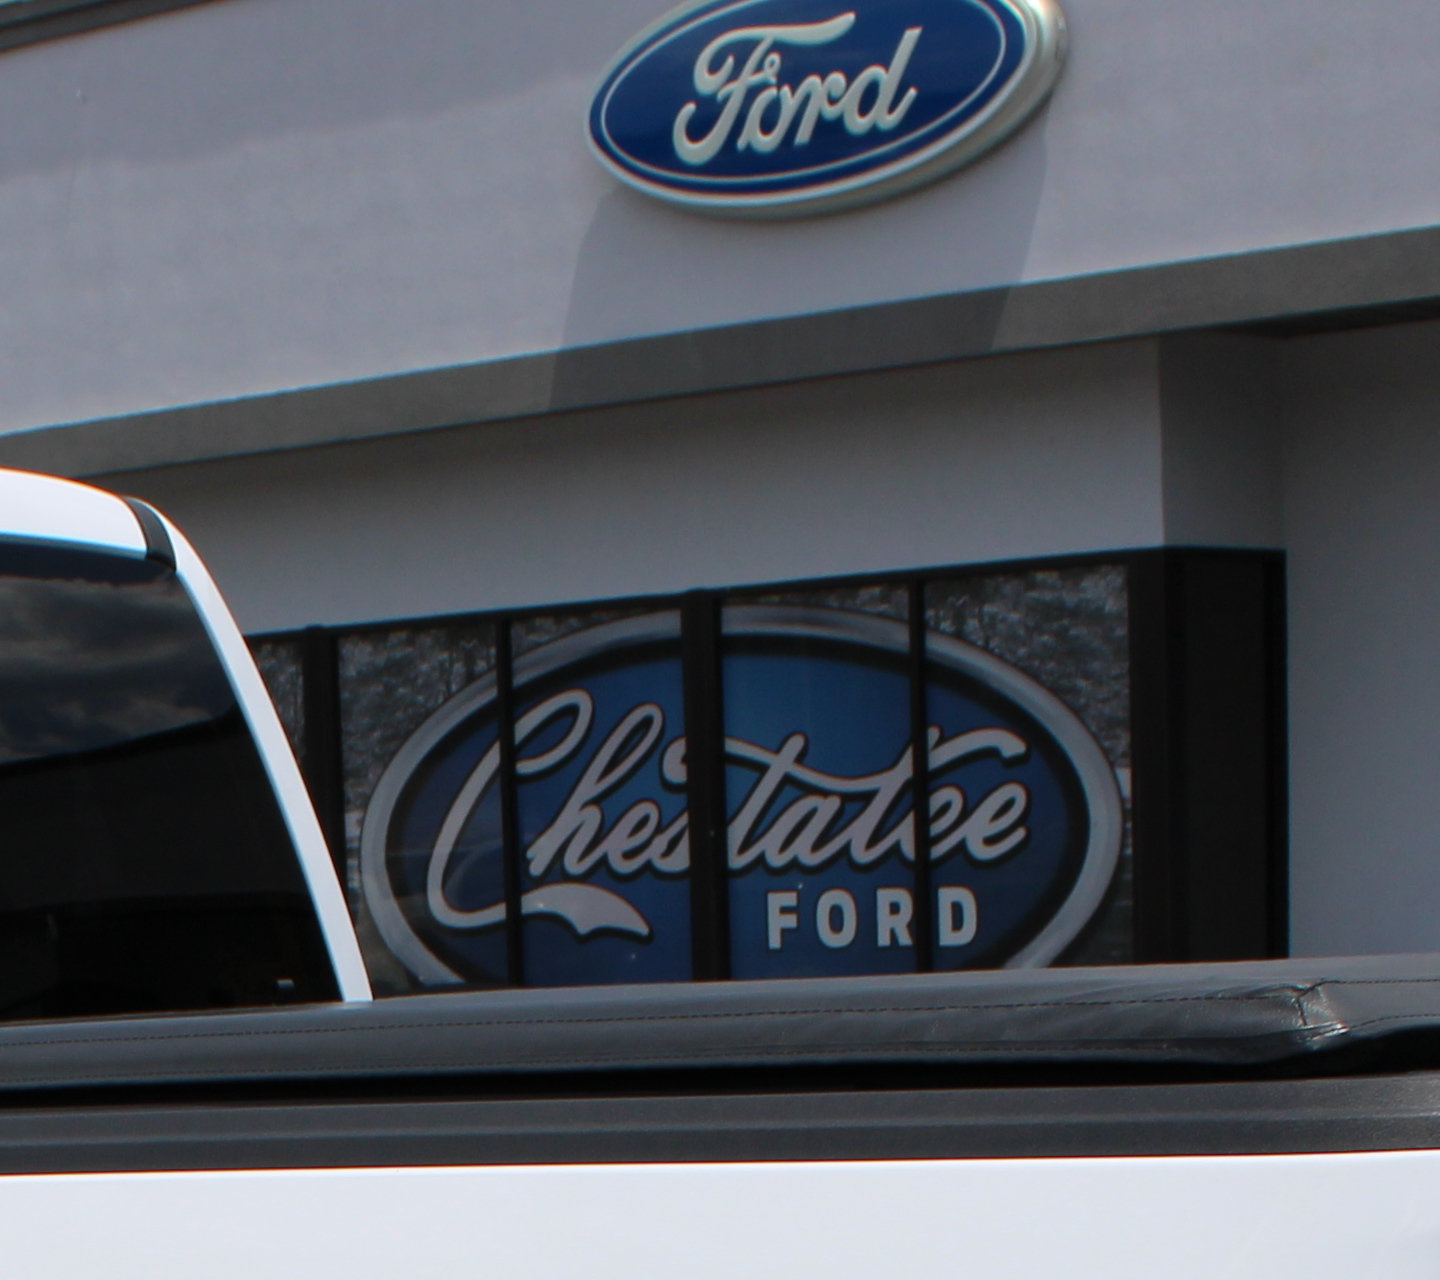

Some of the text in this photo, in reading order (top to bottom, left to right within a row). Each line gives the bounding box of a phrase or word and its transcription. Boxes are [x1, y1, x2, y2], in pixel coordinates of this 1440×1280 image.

[672, 11, 923, 166] Ford
[426, 688, 1030, 938] Chestatee
[766, 886, 979, 950] FORD
